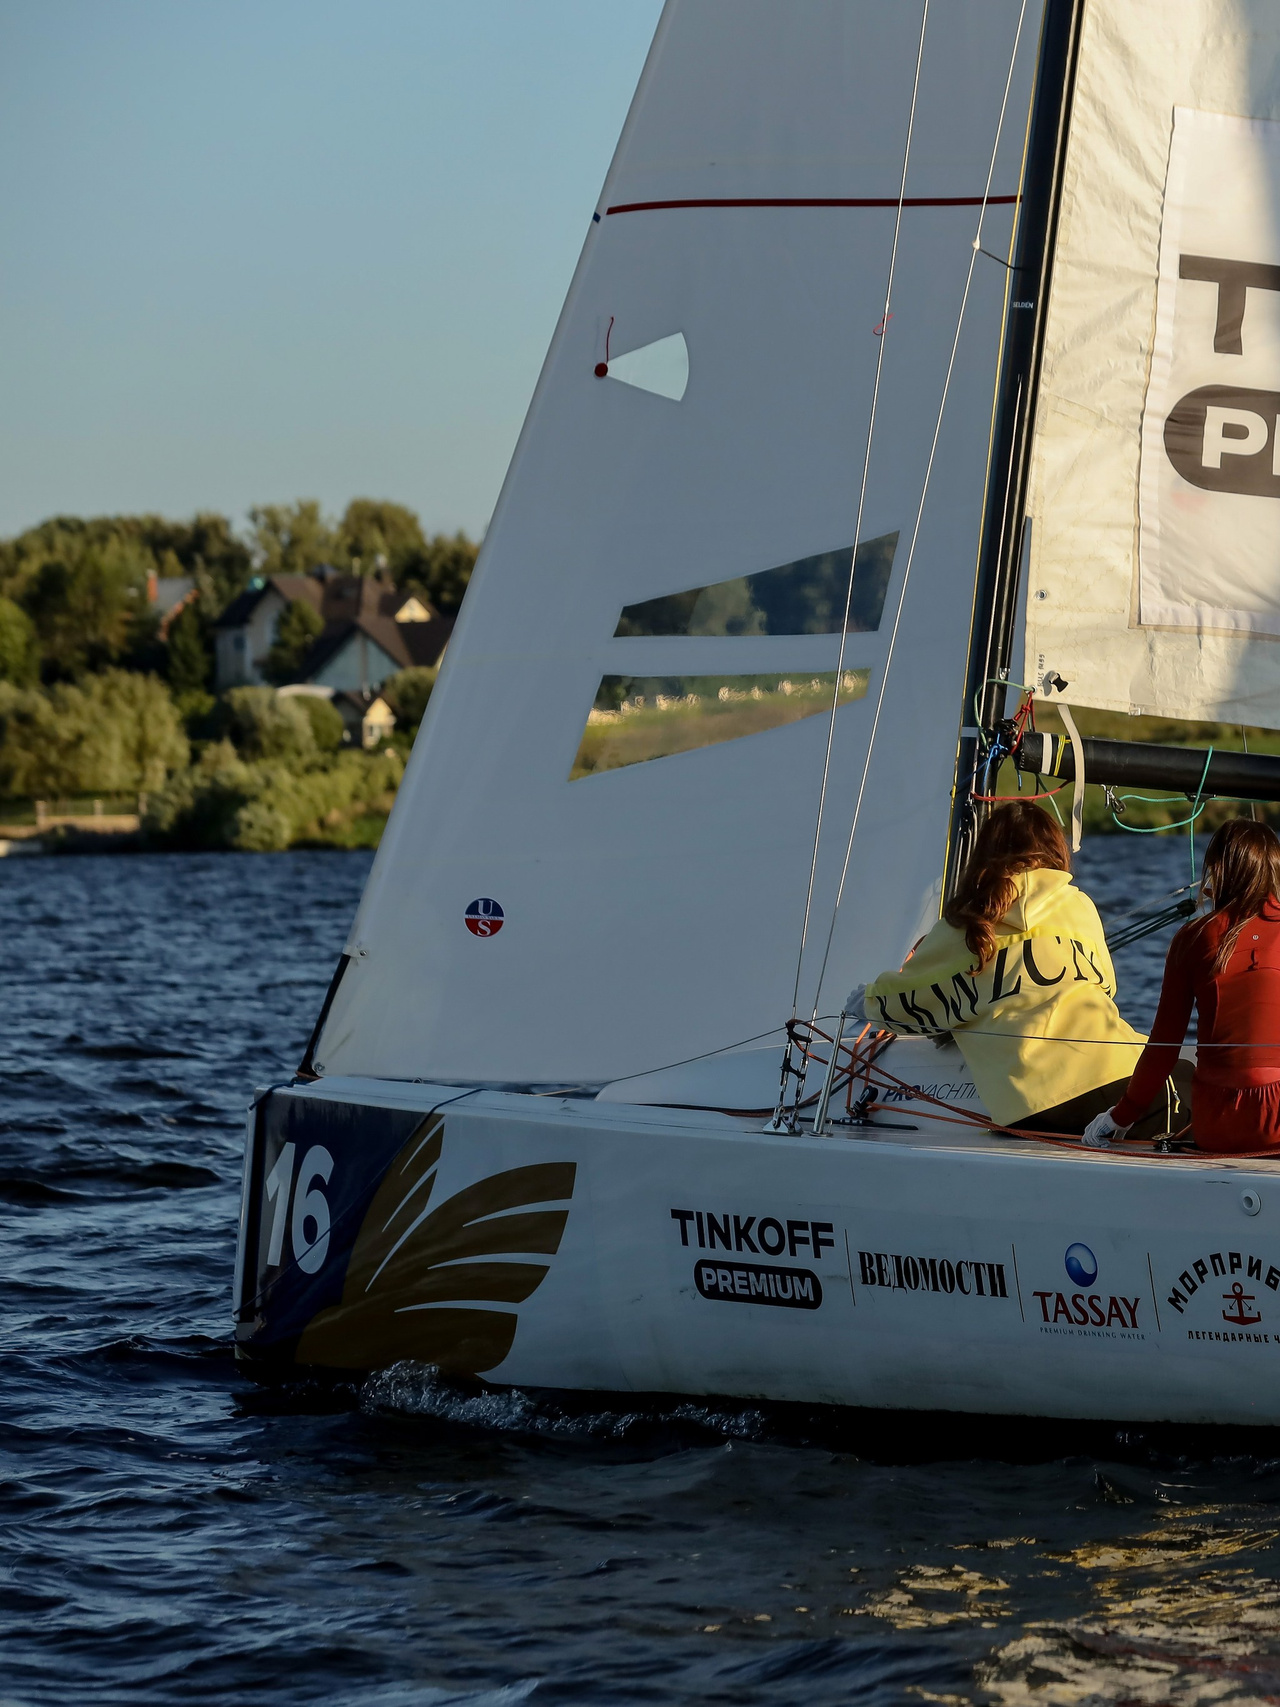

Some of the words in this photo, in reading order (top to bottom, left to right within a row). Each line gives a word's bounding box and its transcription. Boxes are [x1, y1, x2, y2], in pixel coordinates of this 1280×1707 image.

[266, 1141, 334, 1274] 16
[670, 1208, 835, 1260] TINKOFF
[701, 1267, 815, 1301] PREMIUM
[858, 1251, 1009, 1299] ВЕДОМОСТИ
[1033, 1291, 1141, 1329] TASSAY
[1040, 1327, 1075, 1335] PREMIUM
[1078, 1329, 1117, 1339] DRINKING
[1120, 1333, 1146, 1341] WATER
